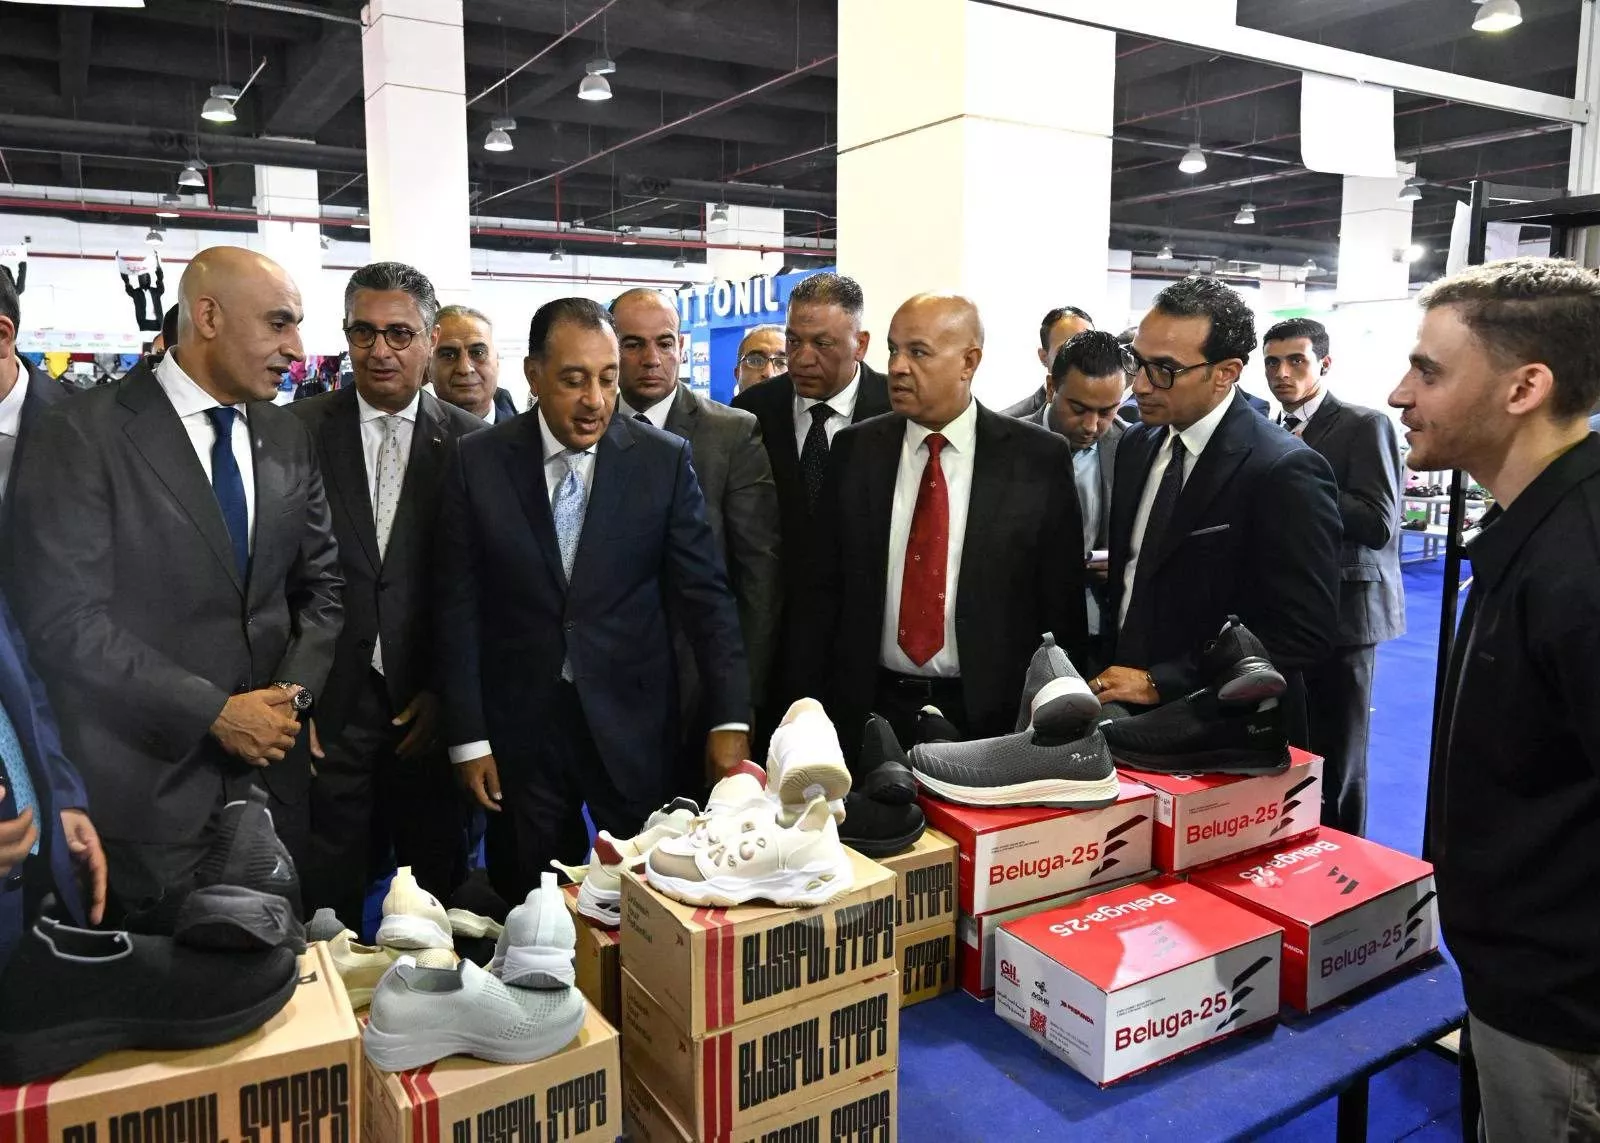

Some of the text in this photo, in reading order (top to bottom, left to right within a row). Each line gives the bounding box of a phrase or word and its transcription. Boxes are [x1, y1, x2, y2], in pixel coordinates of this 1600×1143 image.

[1186, 802, 1279, 845] Beluga-25
[905, 861, 953, 923] STEPS
[989, 842, 1099, 885] Beluga-25
[1049, 892, 1177, 937] Beluga-25
[742, 894, 895, 1006] BLISSFUL STEPS
[1320, 923, 1402, 979] Beluga-25
[738, 992, 889, 1112] BLISSFUL STEPS
[238, 1063, 349, 1143] STEPS
[546, 1068, 607, 1143] STEPS
